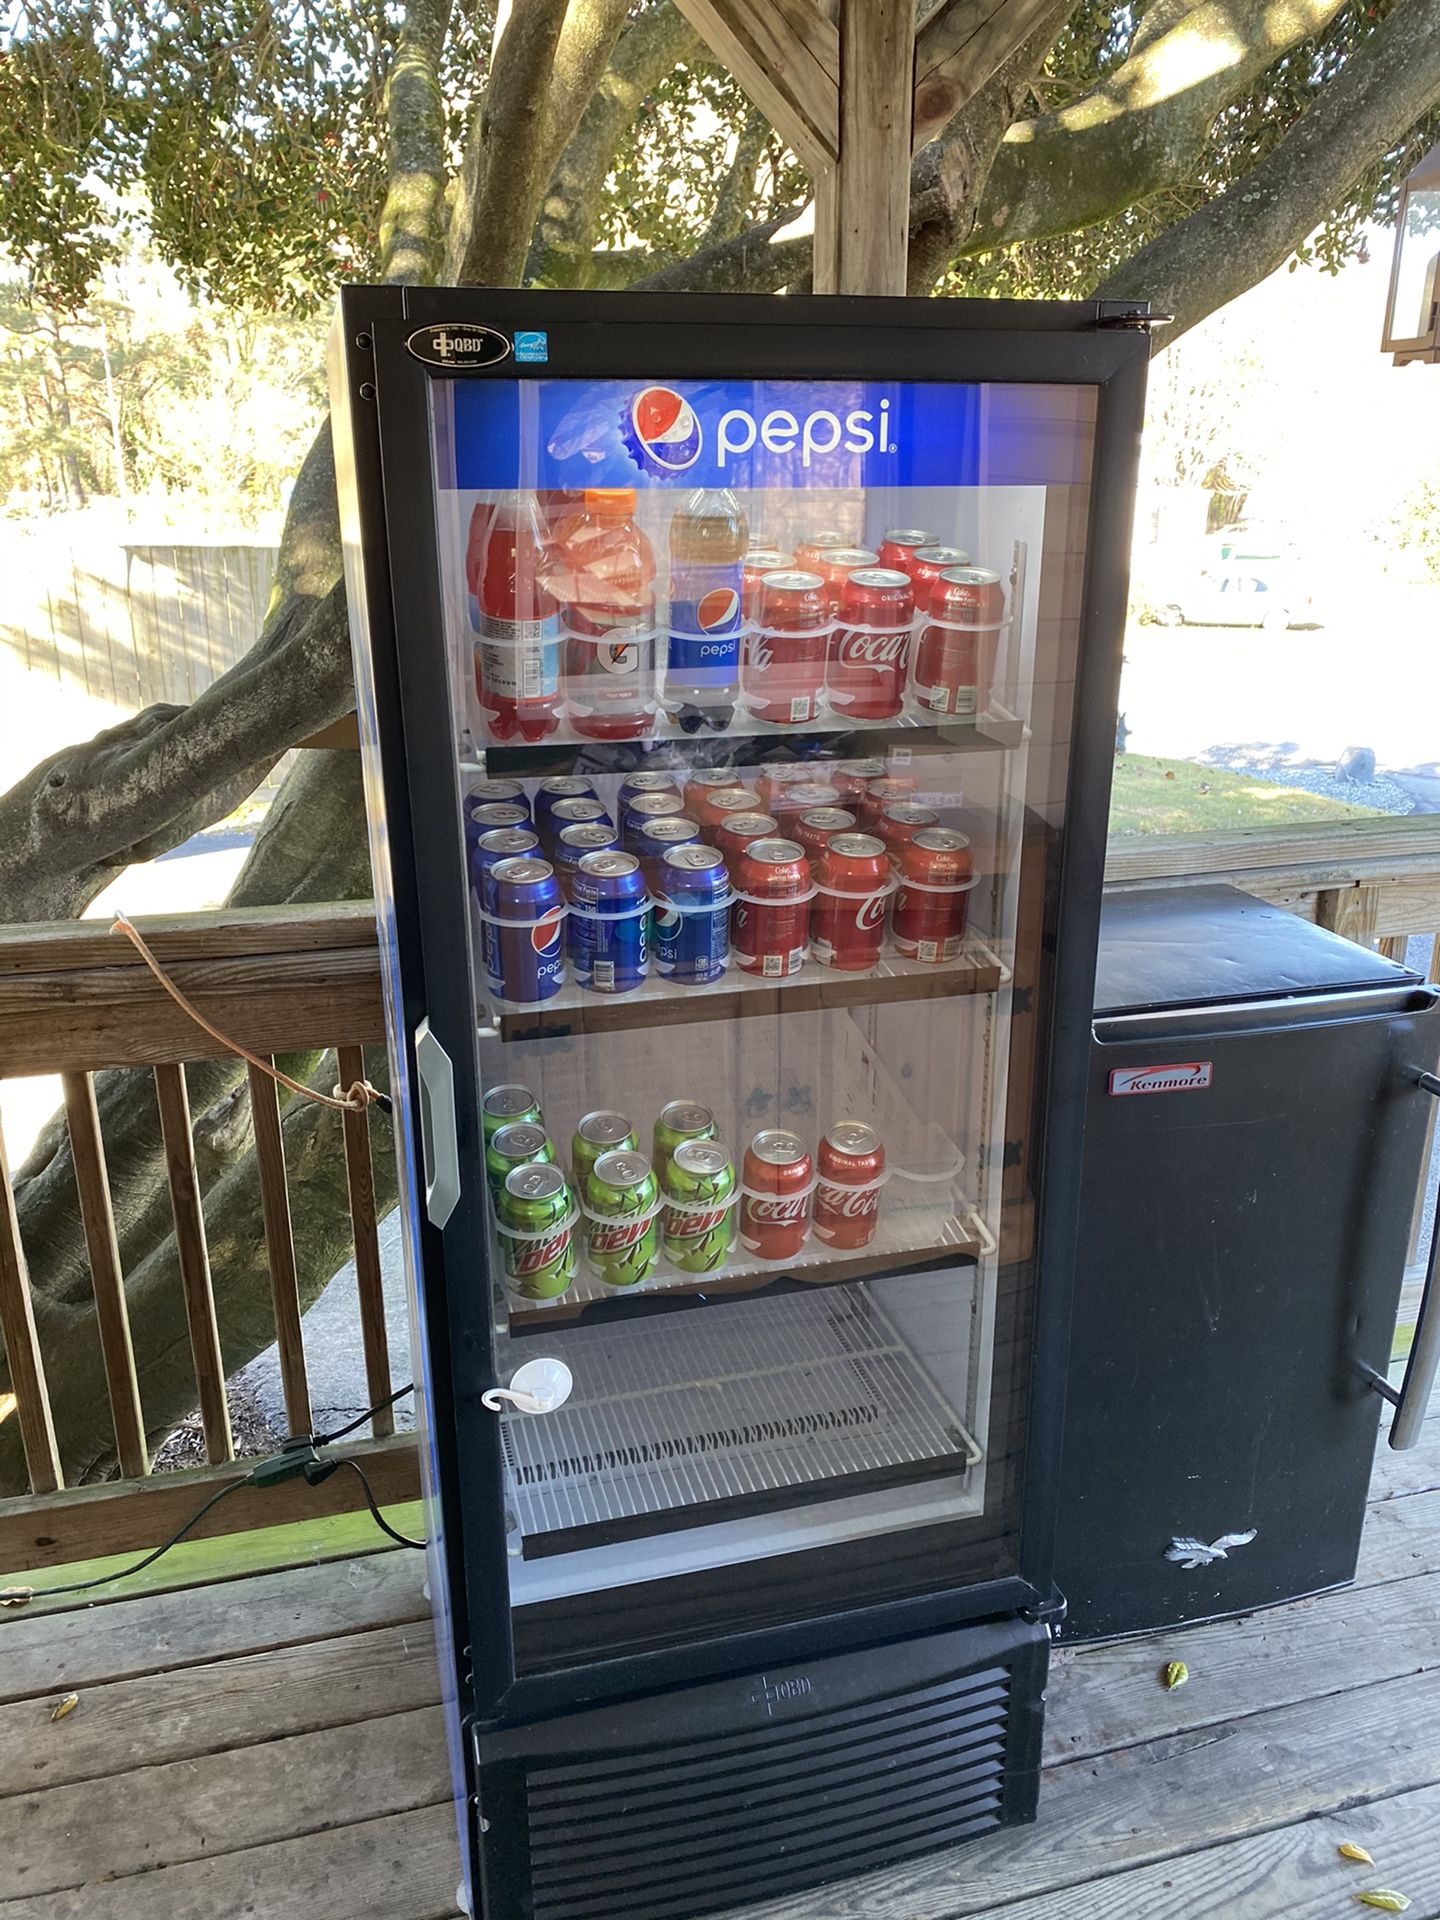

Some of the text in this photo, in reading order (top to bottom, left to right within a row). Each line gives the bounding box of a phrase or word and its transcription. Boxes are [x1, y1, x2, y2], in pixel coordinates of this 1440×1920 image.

[454, 338, 482, 353] QBD
[717, 398, 890, 468] pepsi
[700, 640, 736, 658] pepsi
[1130, 1076, 1207, 1090] Kenmore
